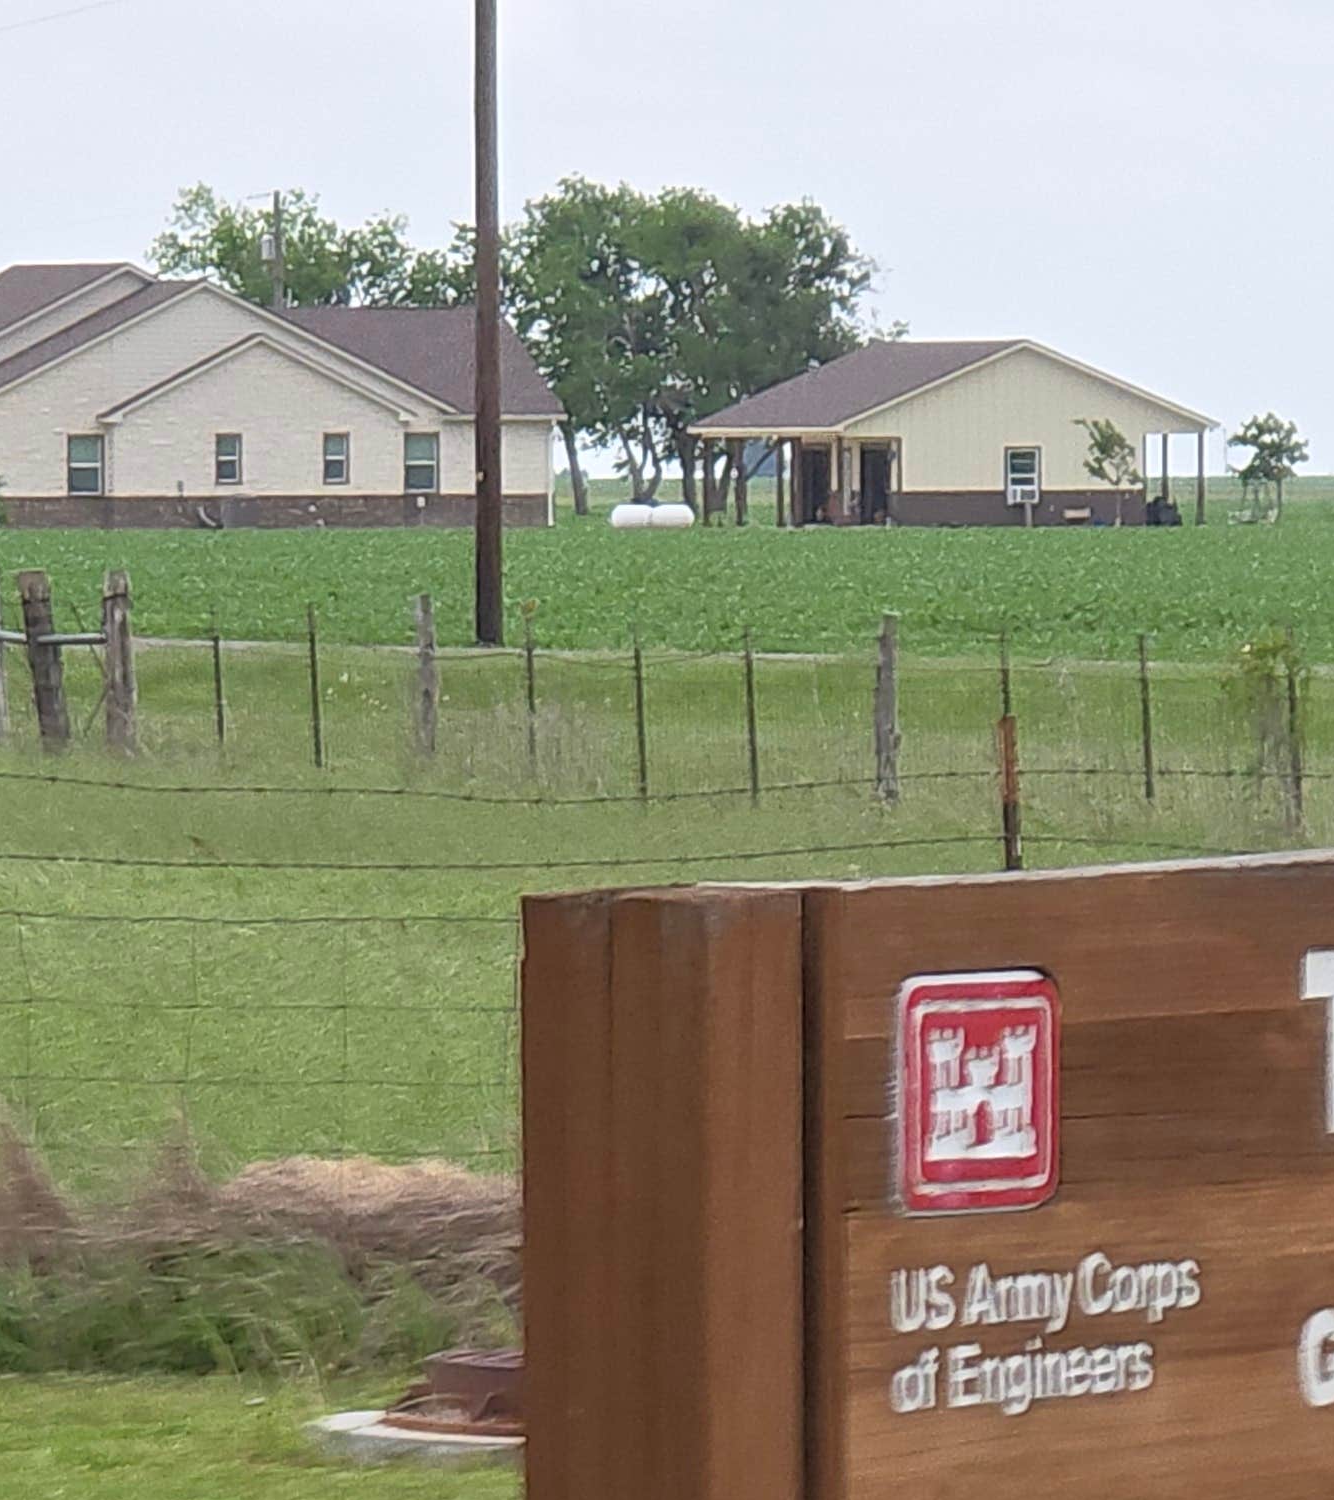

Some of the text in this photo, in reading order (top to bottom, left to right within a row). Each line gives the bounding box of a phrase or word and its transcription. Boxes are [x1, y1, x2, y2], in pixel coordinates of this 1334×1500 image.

[891, 1251, 1202, 1334] US Army Corps
[891, 1335, 1154, 1415] of Engineers
